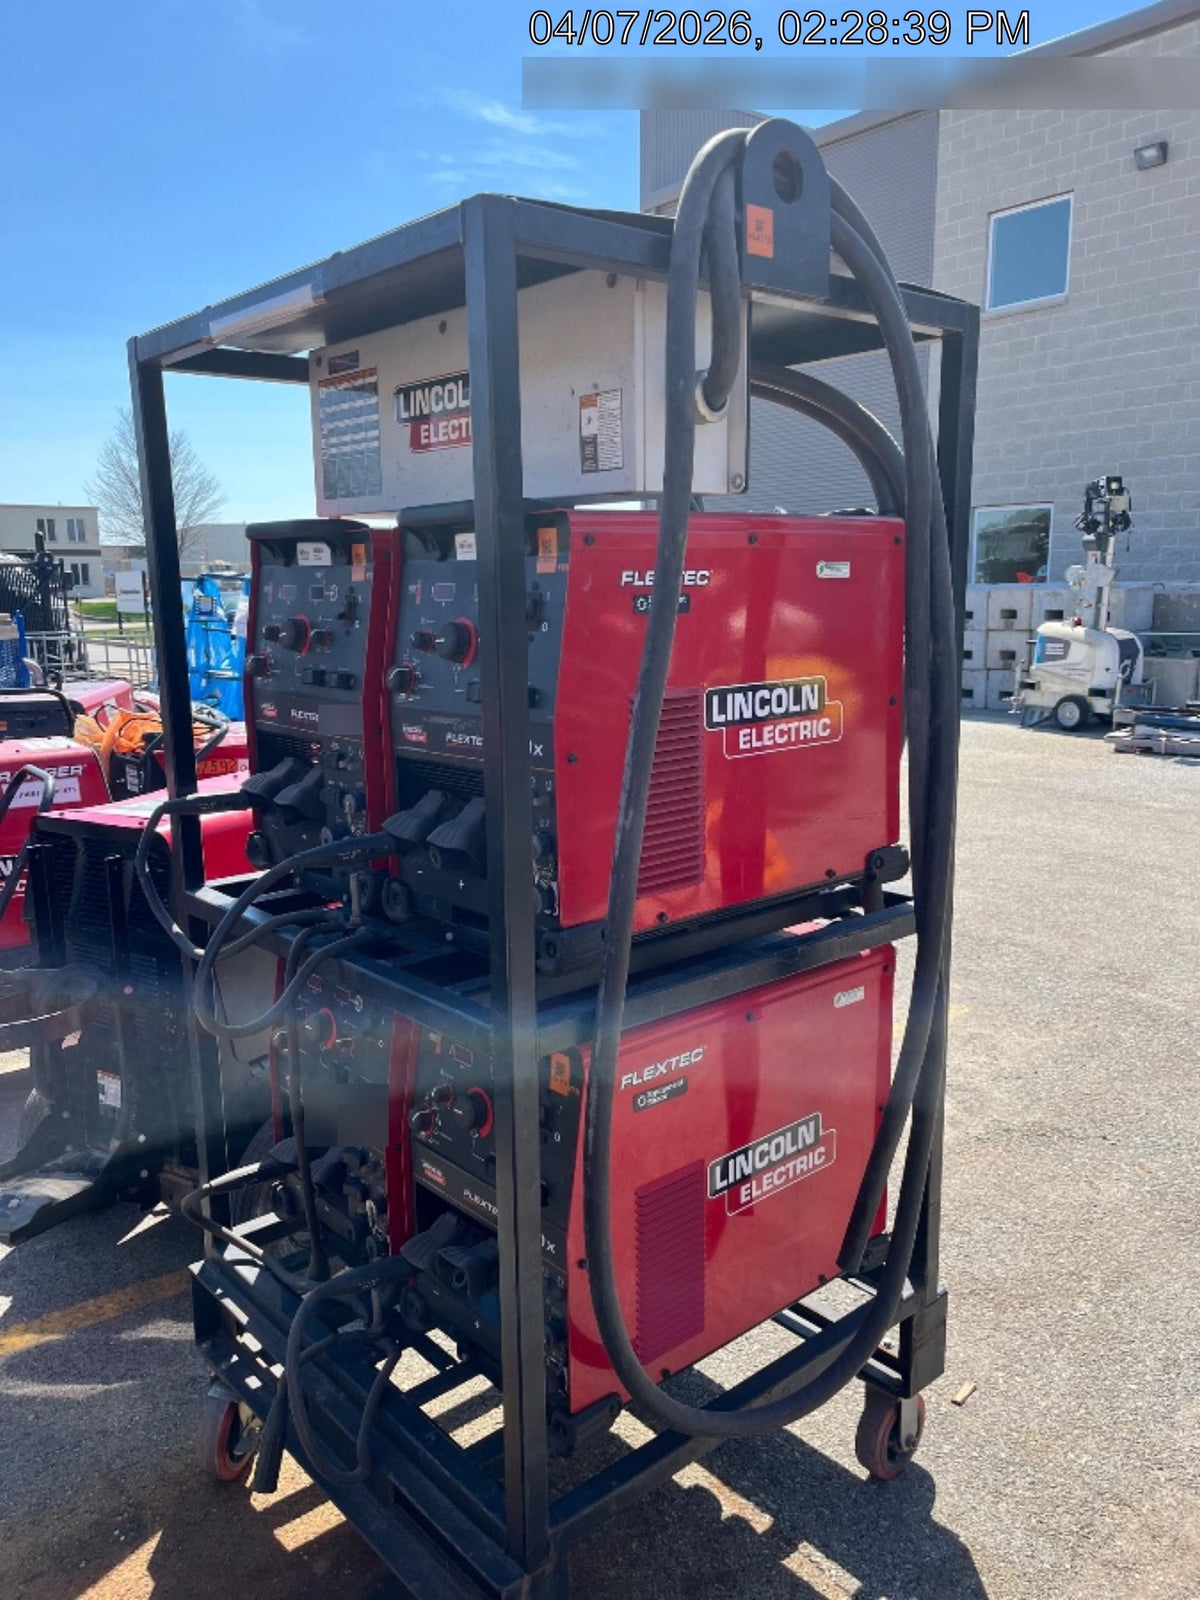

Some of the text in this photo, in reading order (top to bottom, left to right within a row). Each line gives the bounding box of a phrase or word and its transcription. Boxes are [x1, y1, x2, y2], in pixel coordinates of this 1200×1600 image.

[400, 380, 471, 419] LINCOL
[420, 416, 472, 445] ELECT
[621, 570, 710, 586] FLEEC
[712, 684, 819, 723] LINCOLN
[739, 717, 831, 750] ELECTRIC
[620, 1047, 704, 1090] FLEXTEC
[714, 1119, 815, 1191] LINCOLN
[739, 1146, 826, 1205] ELECTRIC
